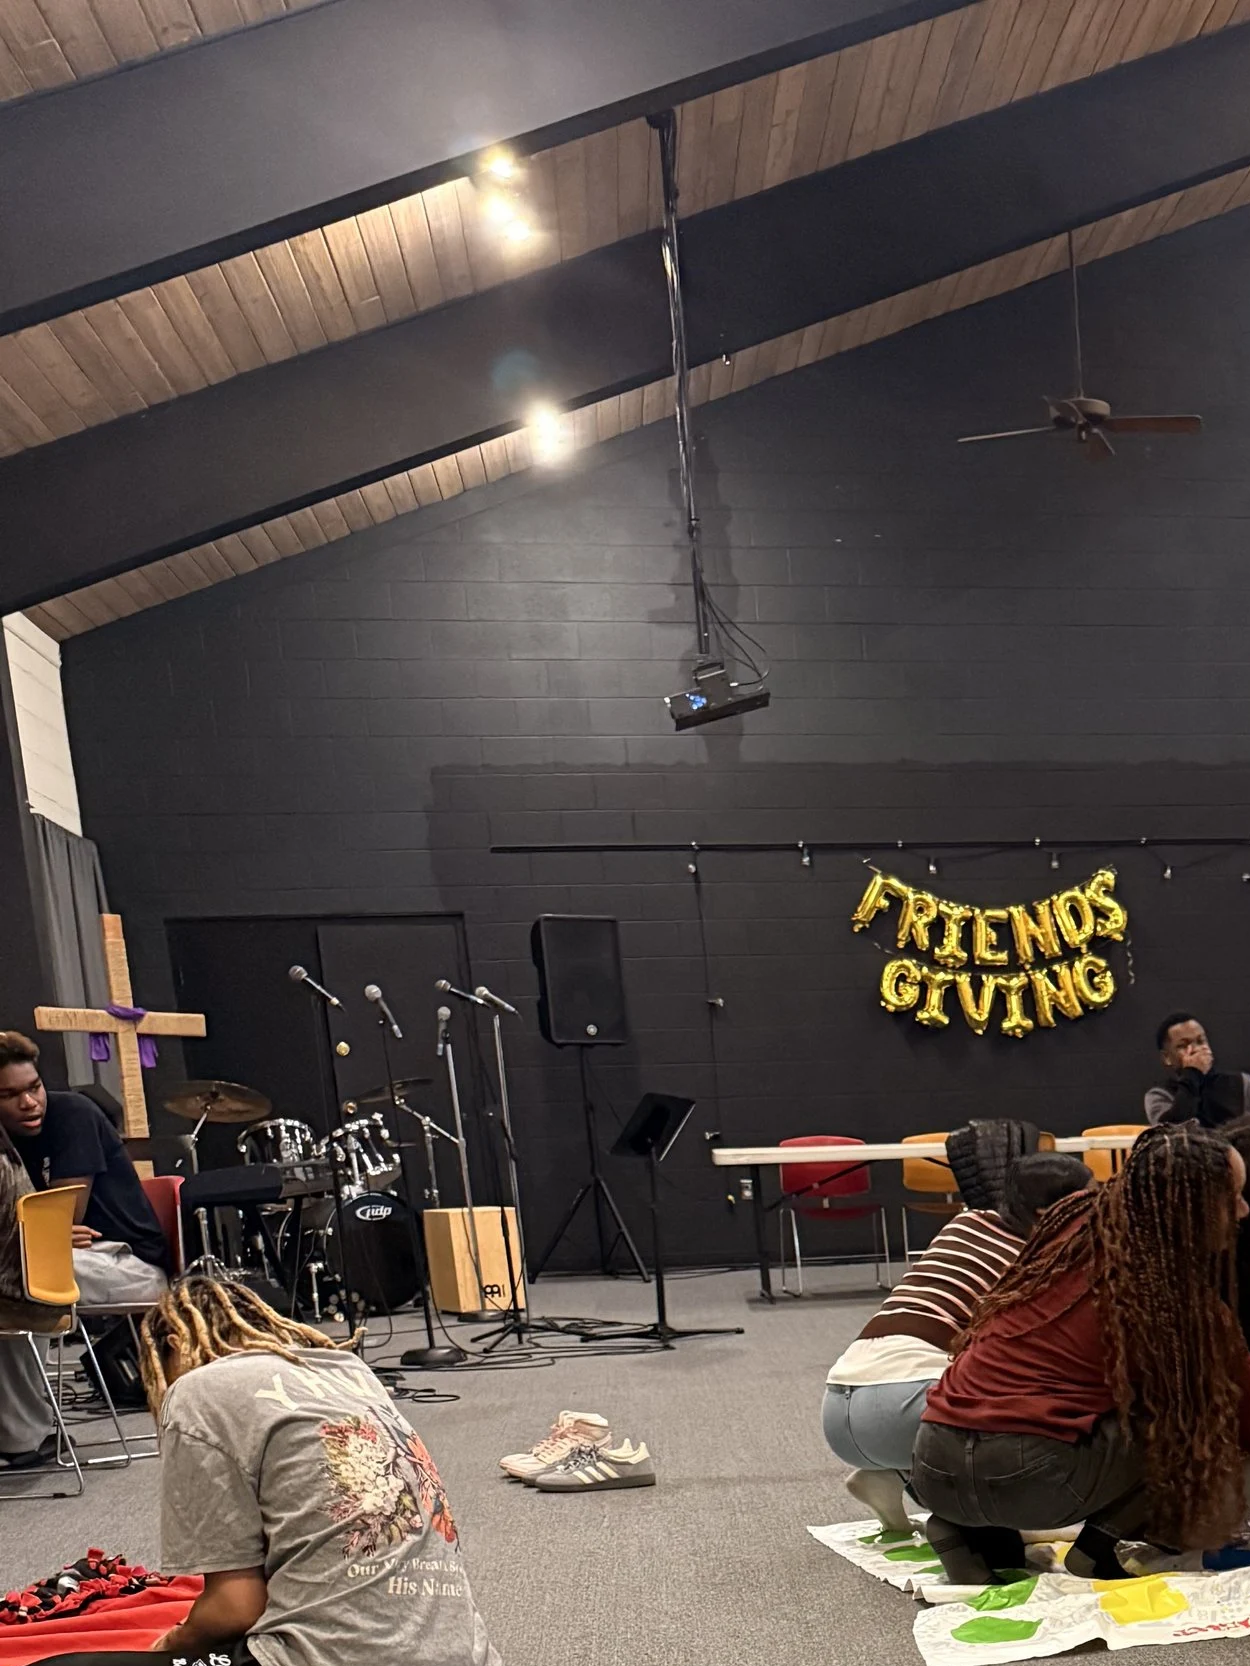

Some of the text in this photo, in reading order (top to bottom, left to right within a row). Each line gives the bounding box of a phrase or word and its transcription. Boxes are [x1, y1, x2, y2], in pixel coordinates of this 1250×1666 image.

[851, 867, 1129, 968] FRIENDS
[880, 952, 1116, 1038] GIVING
[347, 1563, 379, 1578] Our
[384, 1557, 410, 1573] Vy
[387, 1576, 418, 1596] His
